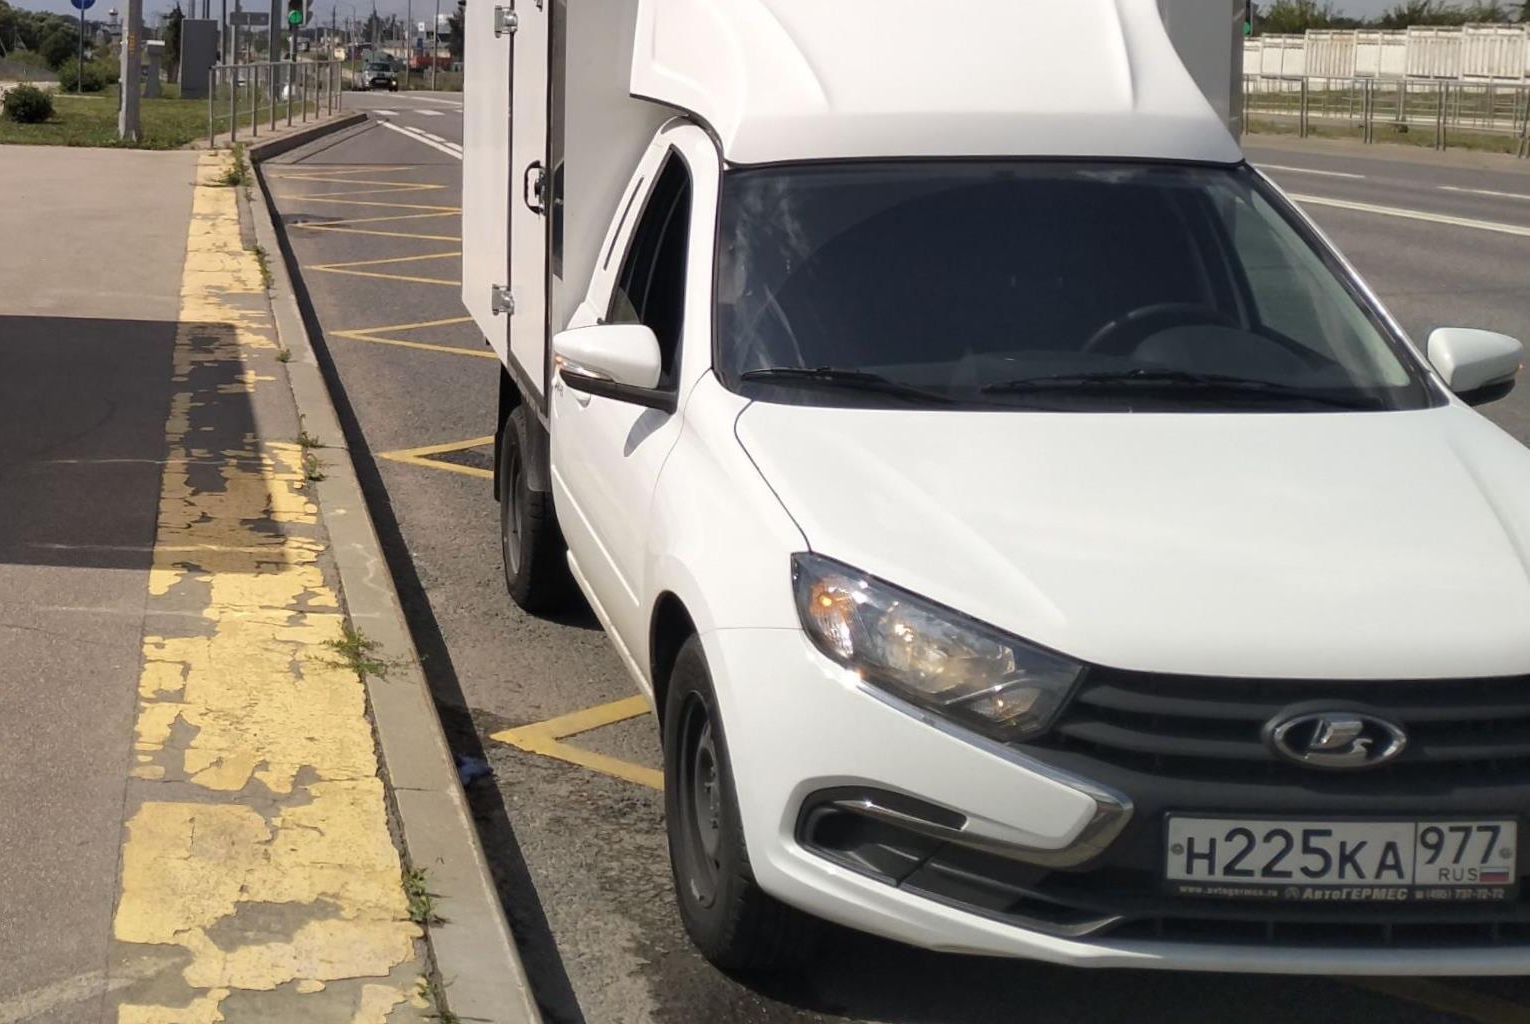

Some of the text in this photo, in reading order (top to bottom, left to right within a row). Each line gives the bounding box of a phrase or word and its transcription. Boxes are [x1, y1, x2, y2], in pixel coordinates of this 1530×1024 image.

[1419, 825, 1502, 865] 977
[1438, 866, 1478, 882] RUS
[1302, 886, 1409, 901] АвтоГЕРМЕС
